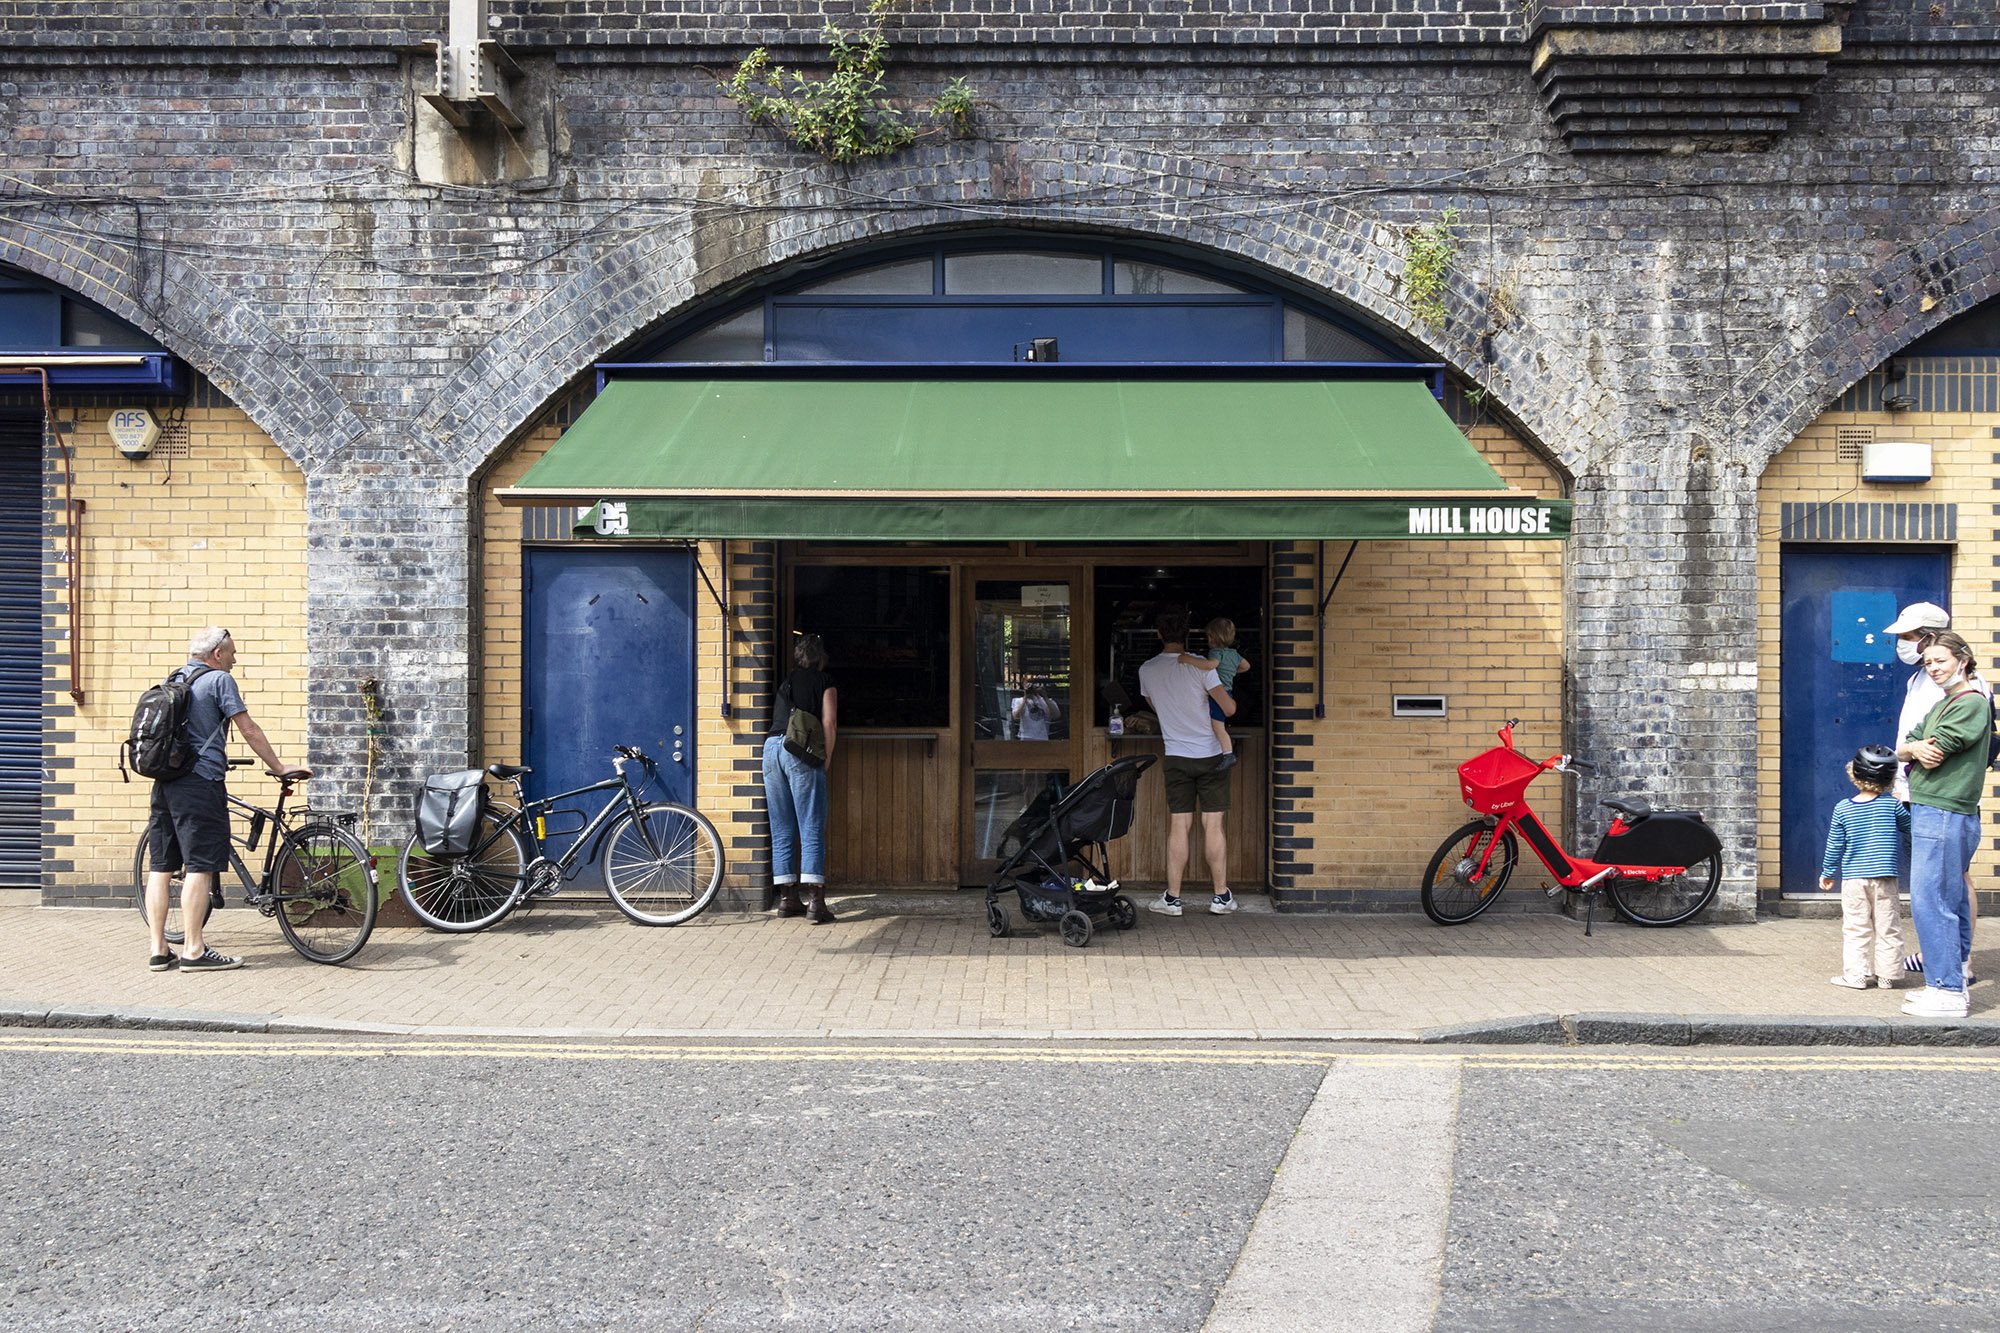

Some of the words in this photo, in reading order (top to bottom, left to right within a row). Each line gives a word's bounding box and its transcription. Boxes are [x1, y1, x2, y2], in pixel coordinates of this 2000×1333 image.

[115, 411, 146, 428] AFS
[1408, 507, 1465, 534] MILL
[1469, 507, 1551, 534] HOUSE
